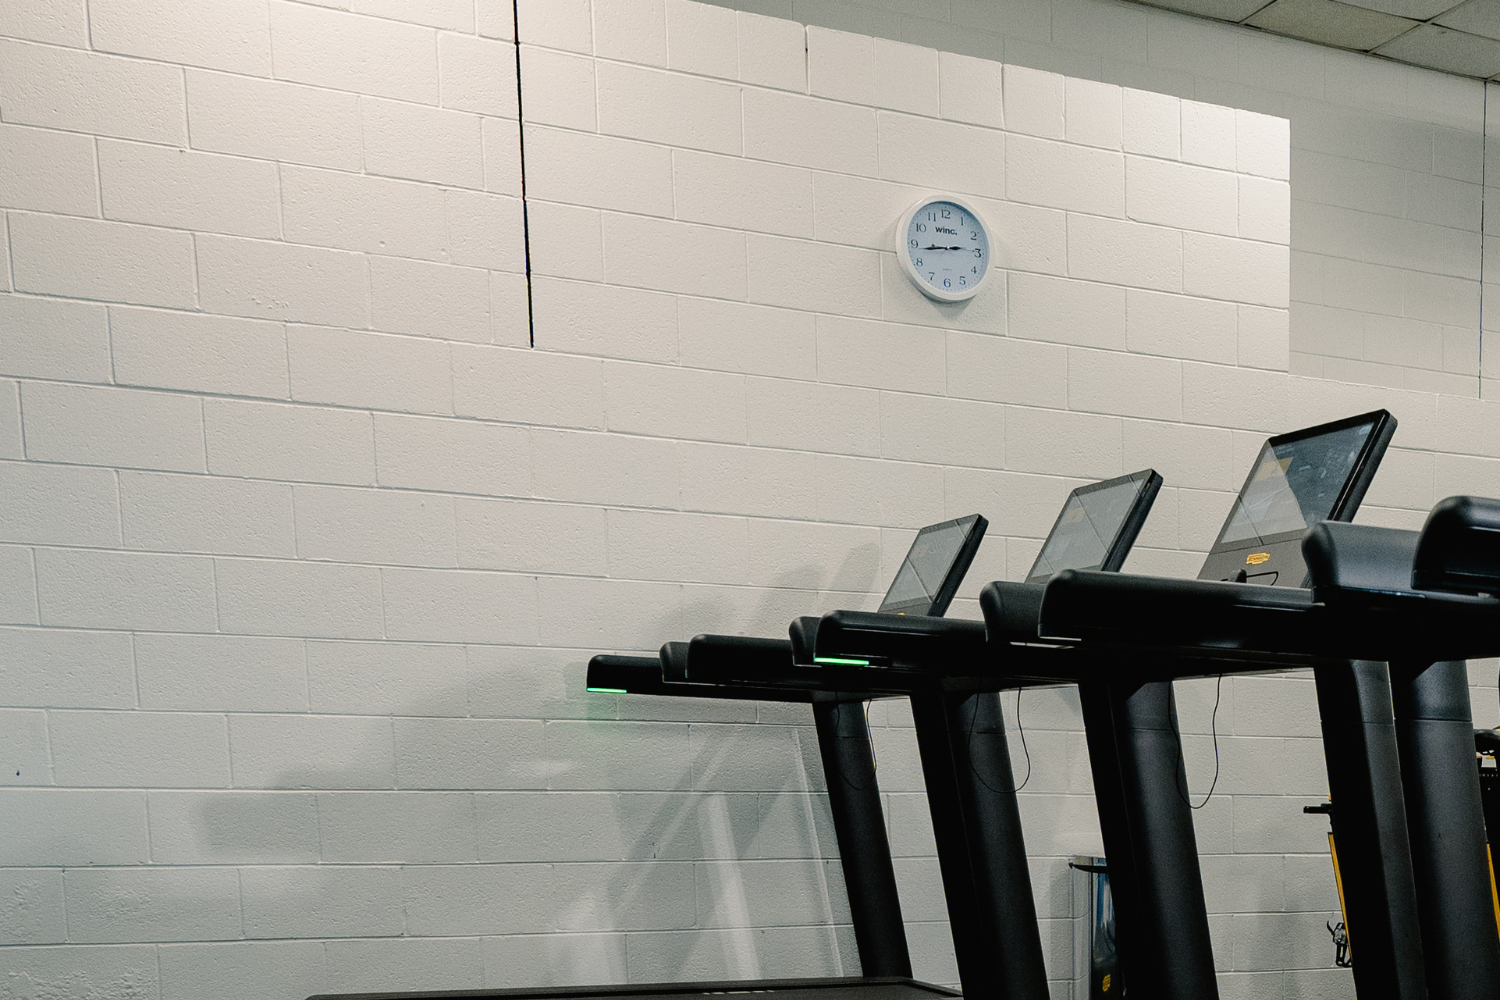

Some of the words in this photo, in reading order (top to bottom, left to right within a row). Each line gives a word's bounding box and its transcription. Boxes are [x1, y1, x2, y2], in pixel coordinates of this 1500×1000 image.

[927, 212, 936, 222] 11
[941, 209, 951, 220] 12
[960, 216, 964, 226] 1
[916, 223, 927, 233] 10
[970, 231, 977, 241] 2
[910, 239, 919, 249] 9
[974, 248, 982, 259] 3
[915, 257, 924, 267] 8
[970, 265, 977, 275] 4
[928, 271, 935, 281] 7
[959, 275, 966, 285] 5
[943, 277, 951, 288] 6
